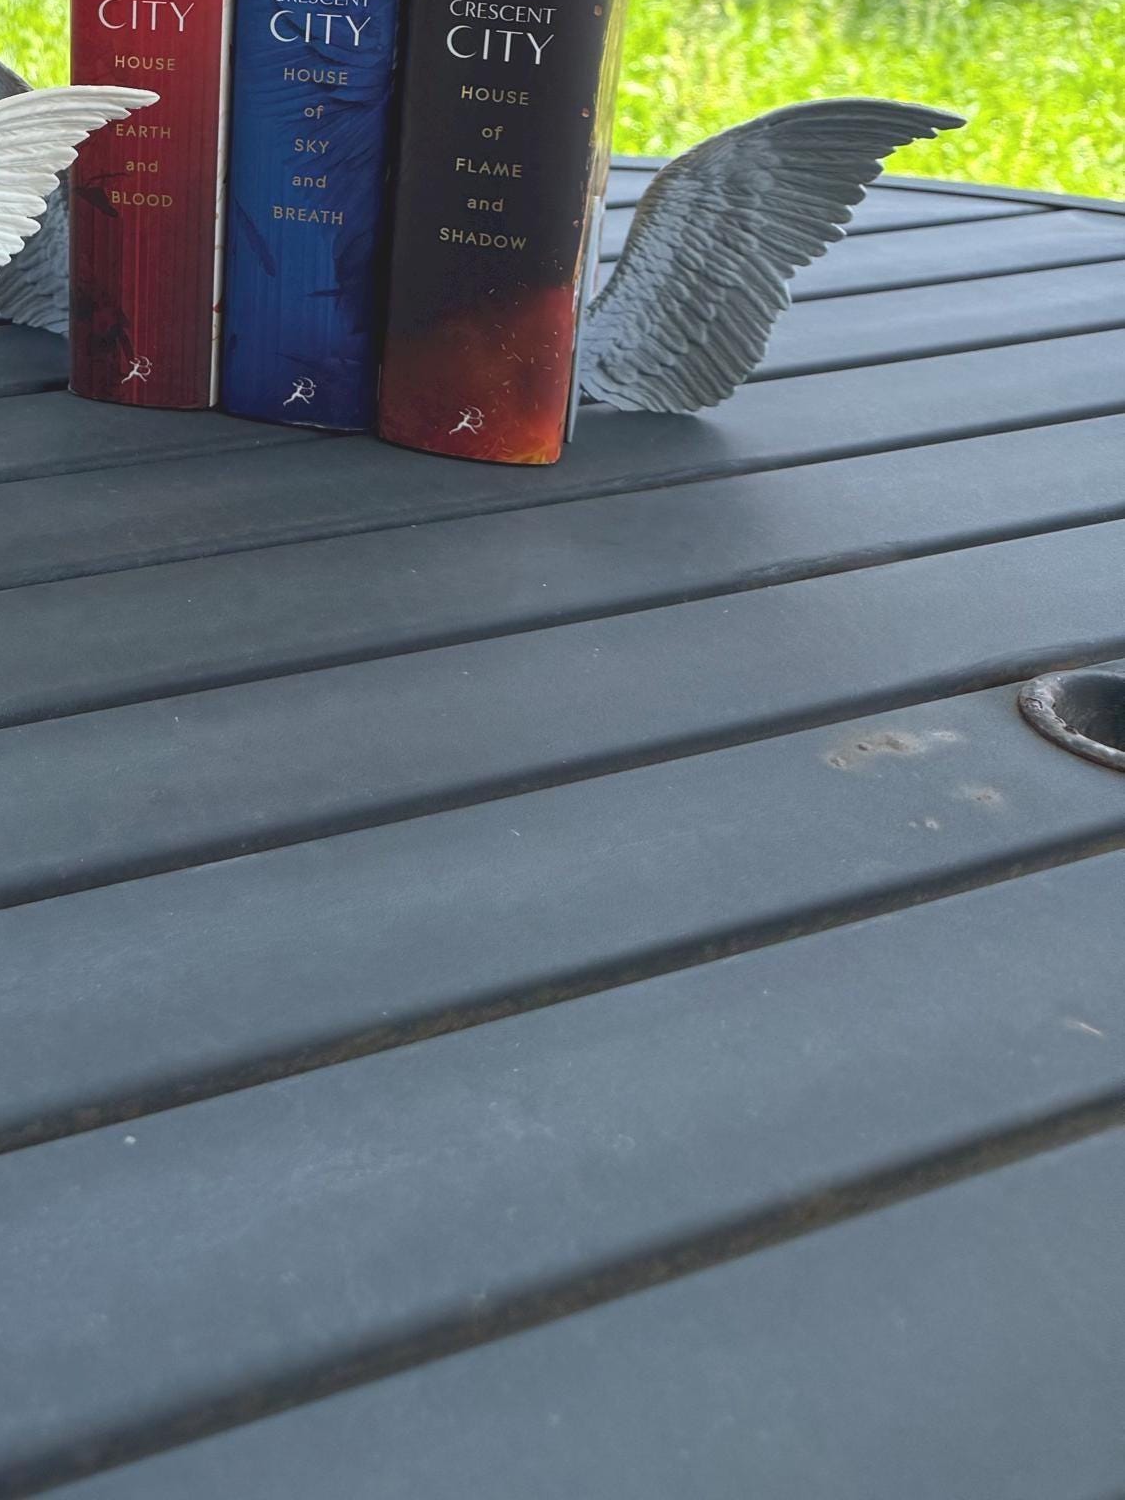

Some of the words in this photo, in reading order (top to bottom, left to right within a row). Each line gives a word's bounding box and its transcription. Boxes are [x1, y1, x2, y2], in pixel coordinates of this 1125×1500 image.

[448, 0, 557, 25] CRESCENT
[269, 10, 372, 47] CITY
[446, 25, 555, 65] CITY
[114, 54, 176, 71] HOUSE
[282, 66, 349, 87] HOUSE
[460, 85, 530, 107] HOUSE
[303, 103, 324, 120] of
[115, 123, 172, 139] EARTH
[481, 122, 503, 141] of
[293, 137, 330, 155] SKY
[125, 160, 159, 173] and
[454, 157, 523, 180] FLAME
[291, 171, 327, 189] and
[111, 191, 173, 208] BLOOD
[466, 194, 504, 213] and
[272, 205, 345, 226] BREATH
[438, 227, 527, 251] SHADOW
